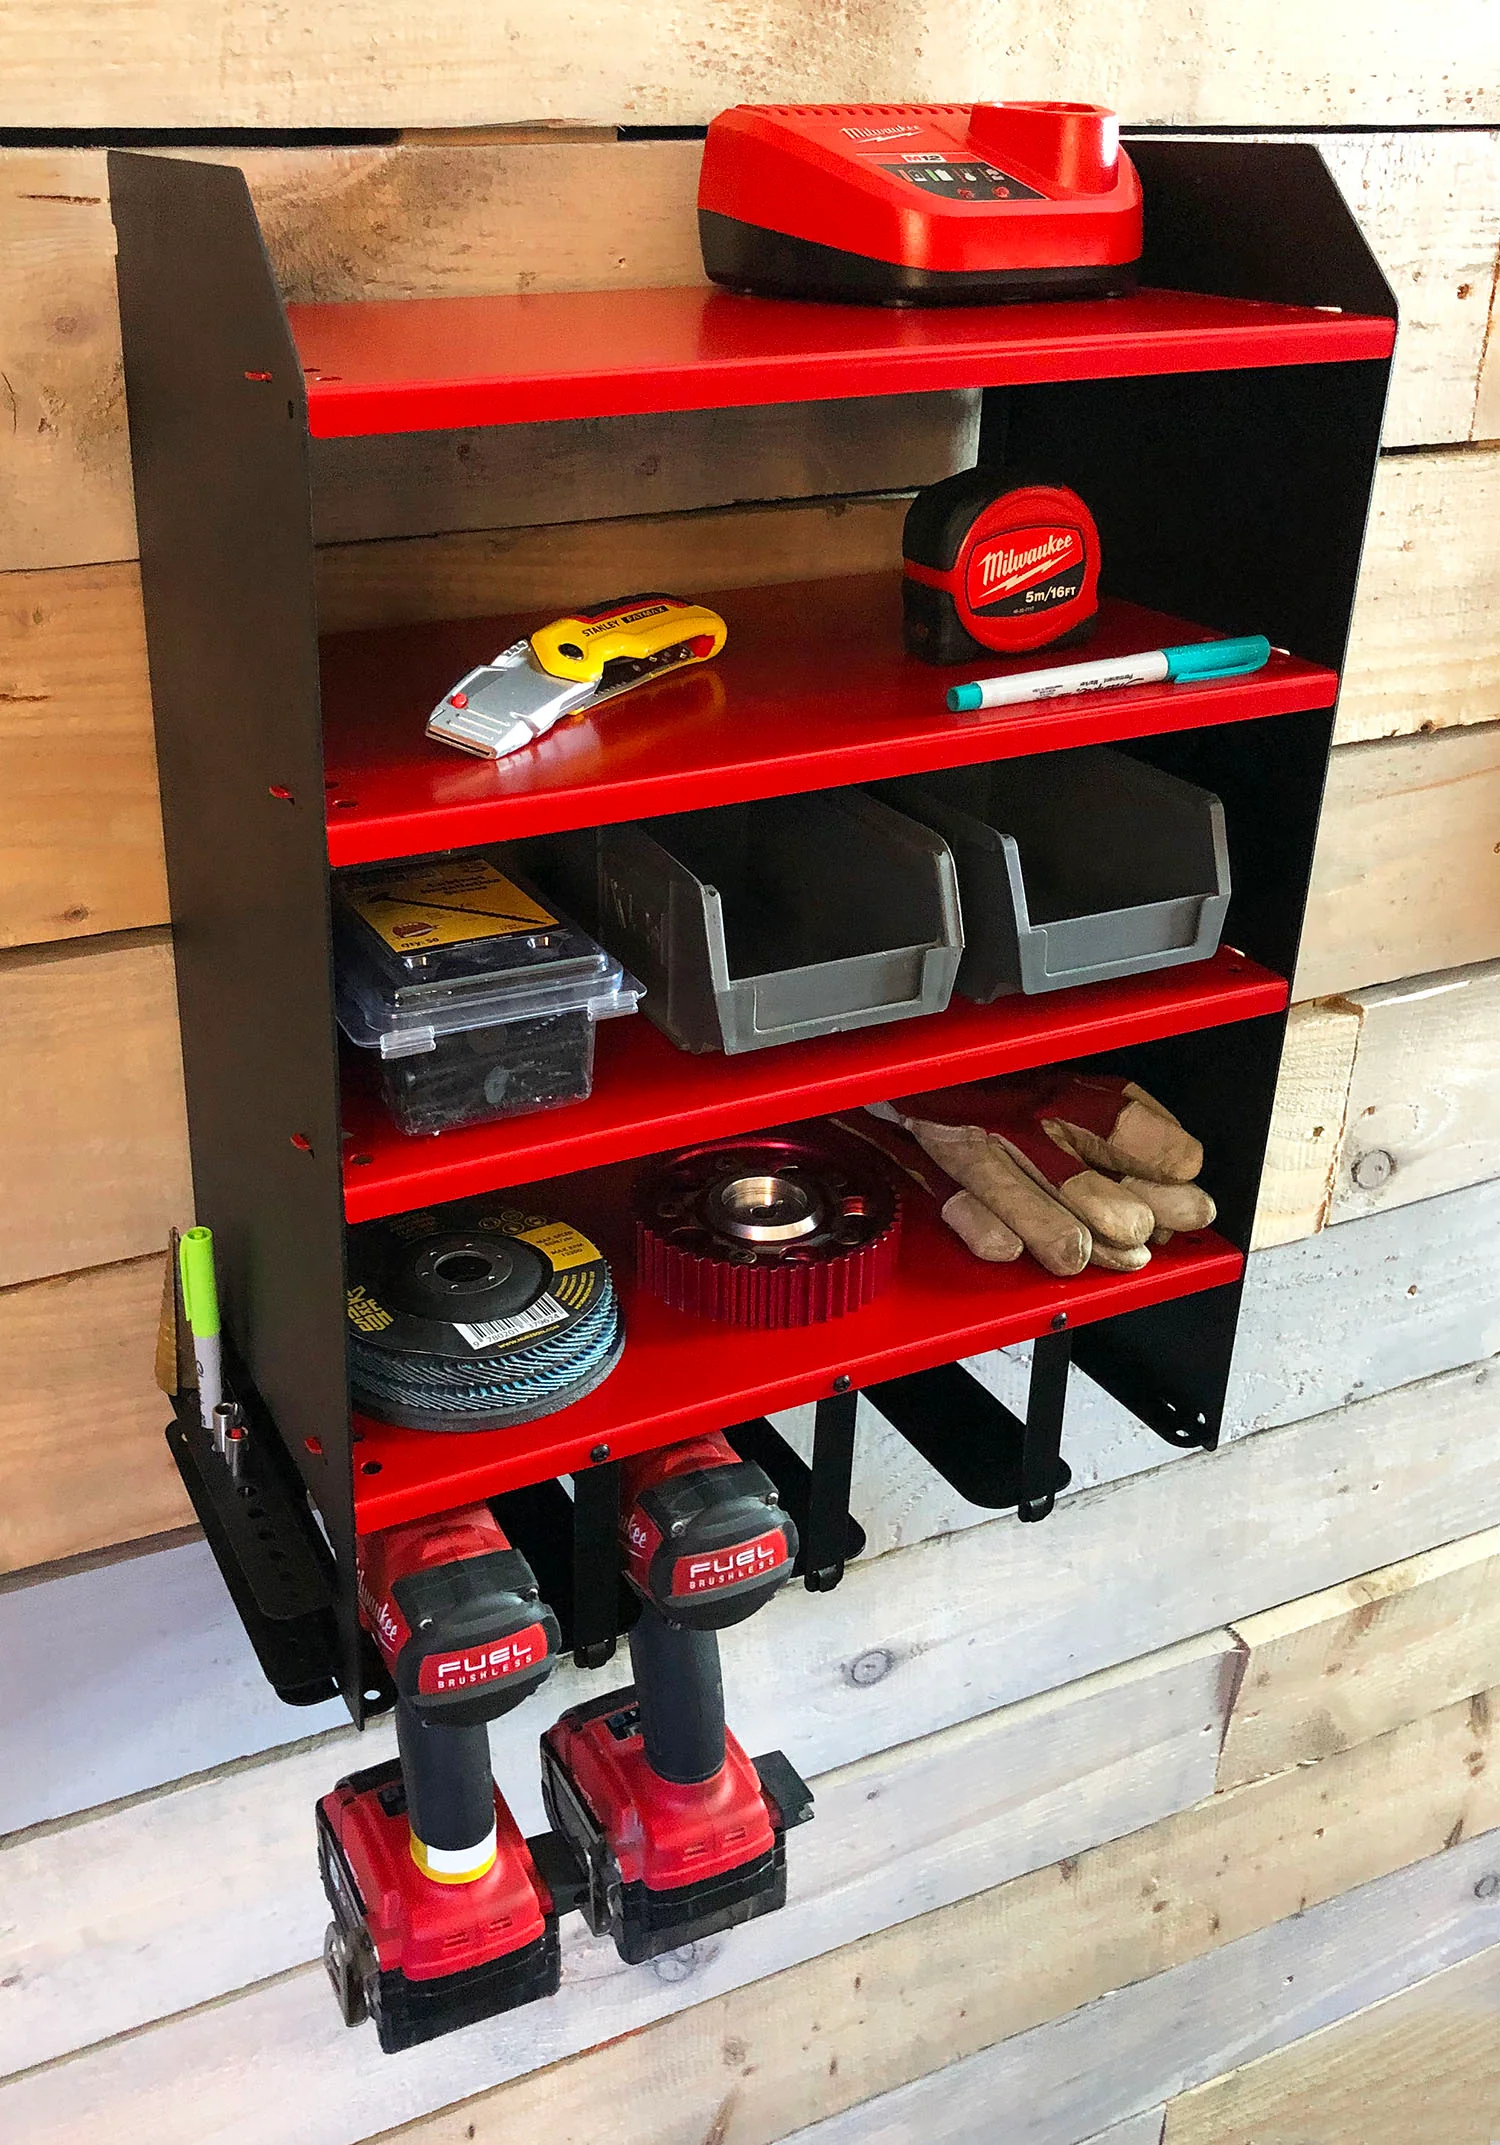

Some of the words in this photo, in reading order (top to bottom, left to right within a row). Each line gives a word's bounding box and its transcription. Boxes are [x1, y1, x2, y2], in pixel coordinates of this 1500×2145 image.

[840, 124, 921, 140] Milwaukee
[976, 534, 1074, 586] Milwaukee
[1025, 586, 1077, 603] 5m/16FT
[581, 619, 621, 637] STANLEY
[689, 1556, 775, 1589] BRUSHLESS
[690, 1546, 775, 1579] FUEL
[438, 1644, 532, 1678] FUEL
[438, 1655, 533, 1689] BRUSHLESS
